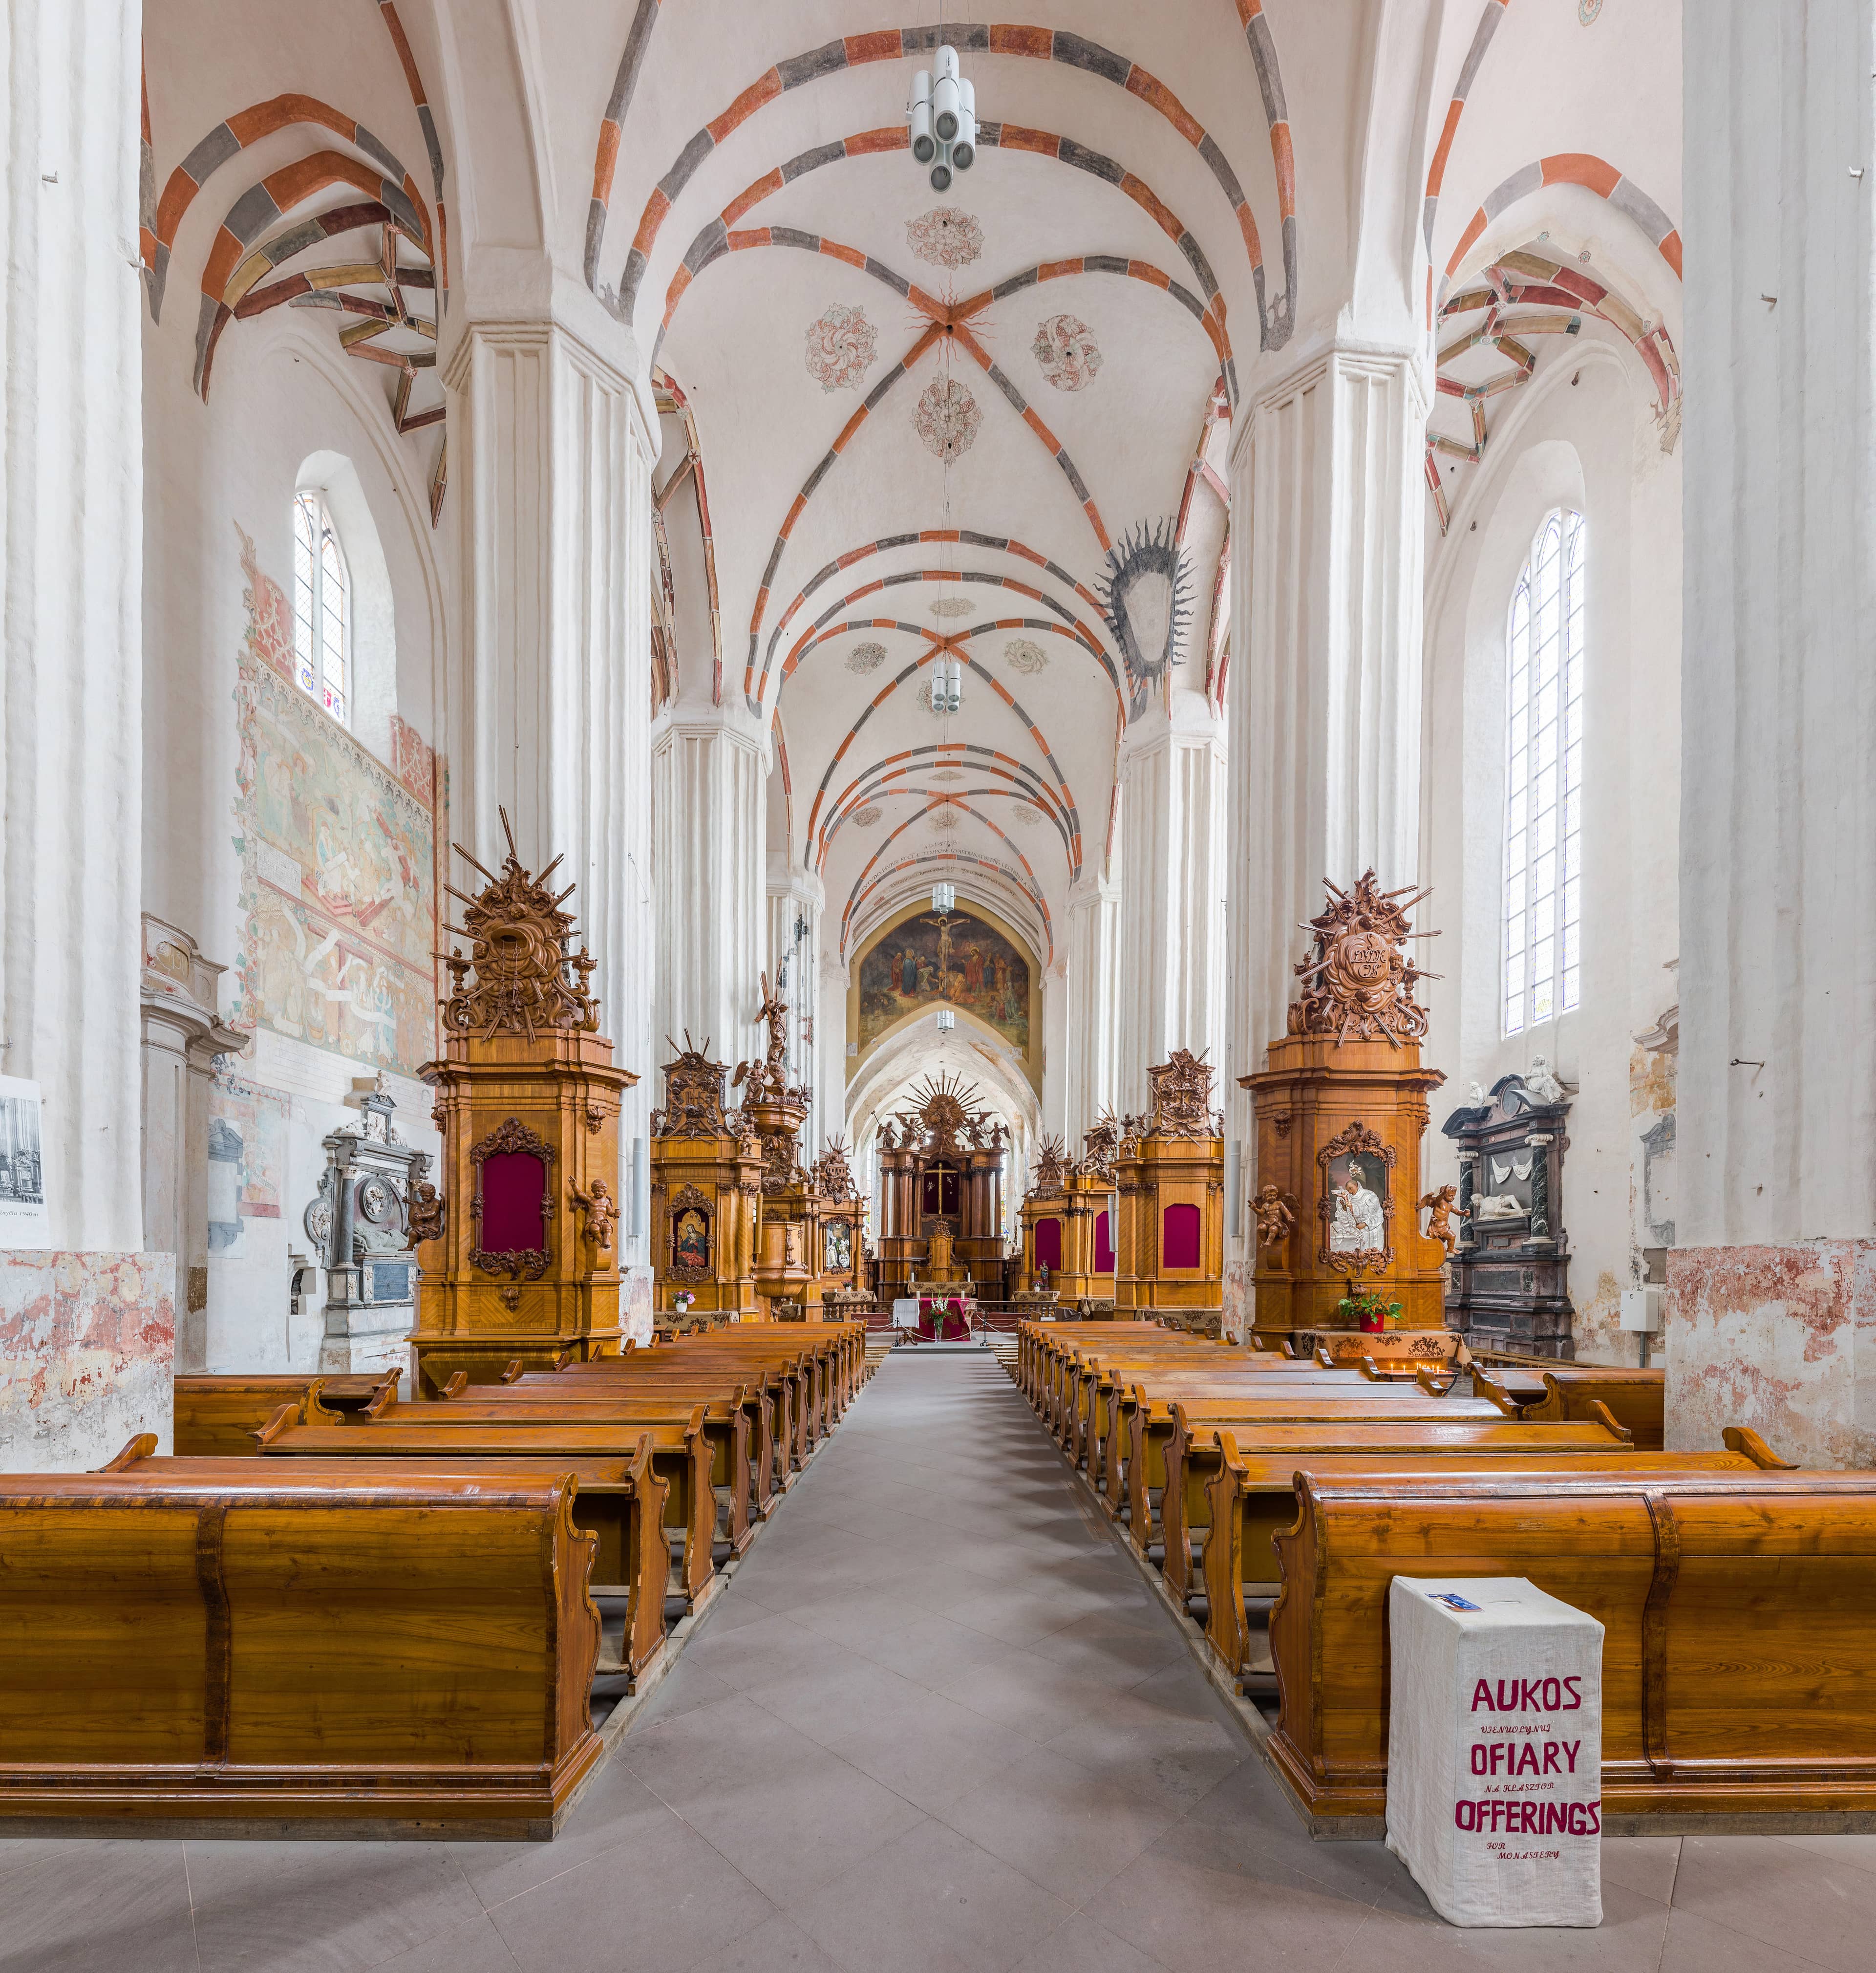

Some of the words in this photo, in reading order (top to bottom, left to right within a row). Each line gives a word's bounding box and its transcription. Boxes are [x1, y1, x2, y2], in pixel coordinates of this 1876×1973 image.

[1471, 1676, 1581, 1713] AUKOS
[1471, 1739, 1581, 1776] OFIARY
[1484, 1784, 1500, 1793] NA
[1503, 1782, 1555, 1793] KLASZTOR
[1455, 1800, 1601, 1836] OFFERINGS
[1497, 1851, 1560, 1859] MONASTERY
